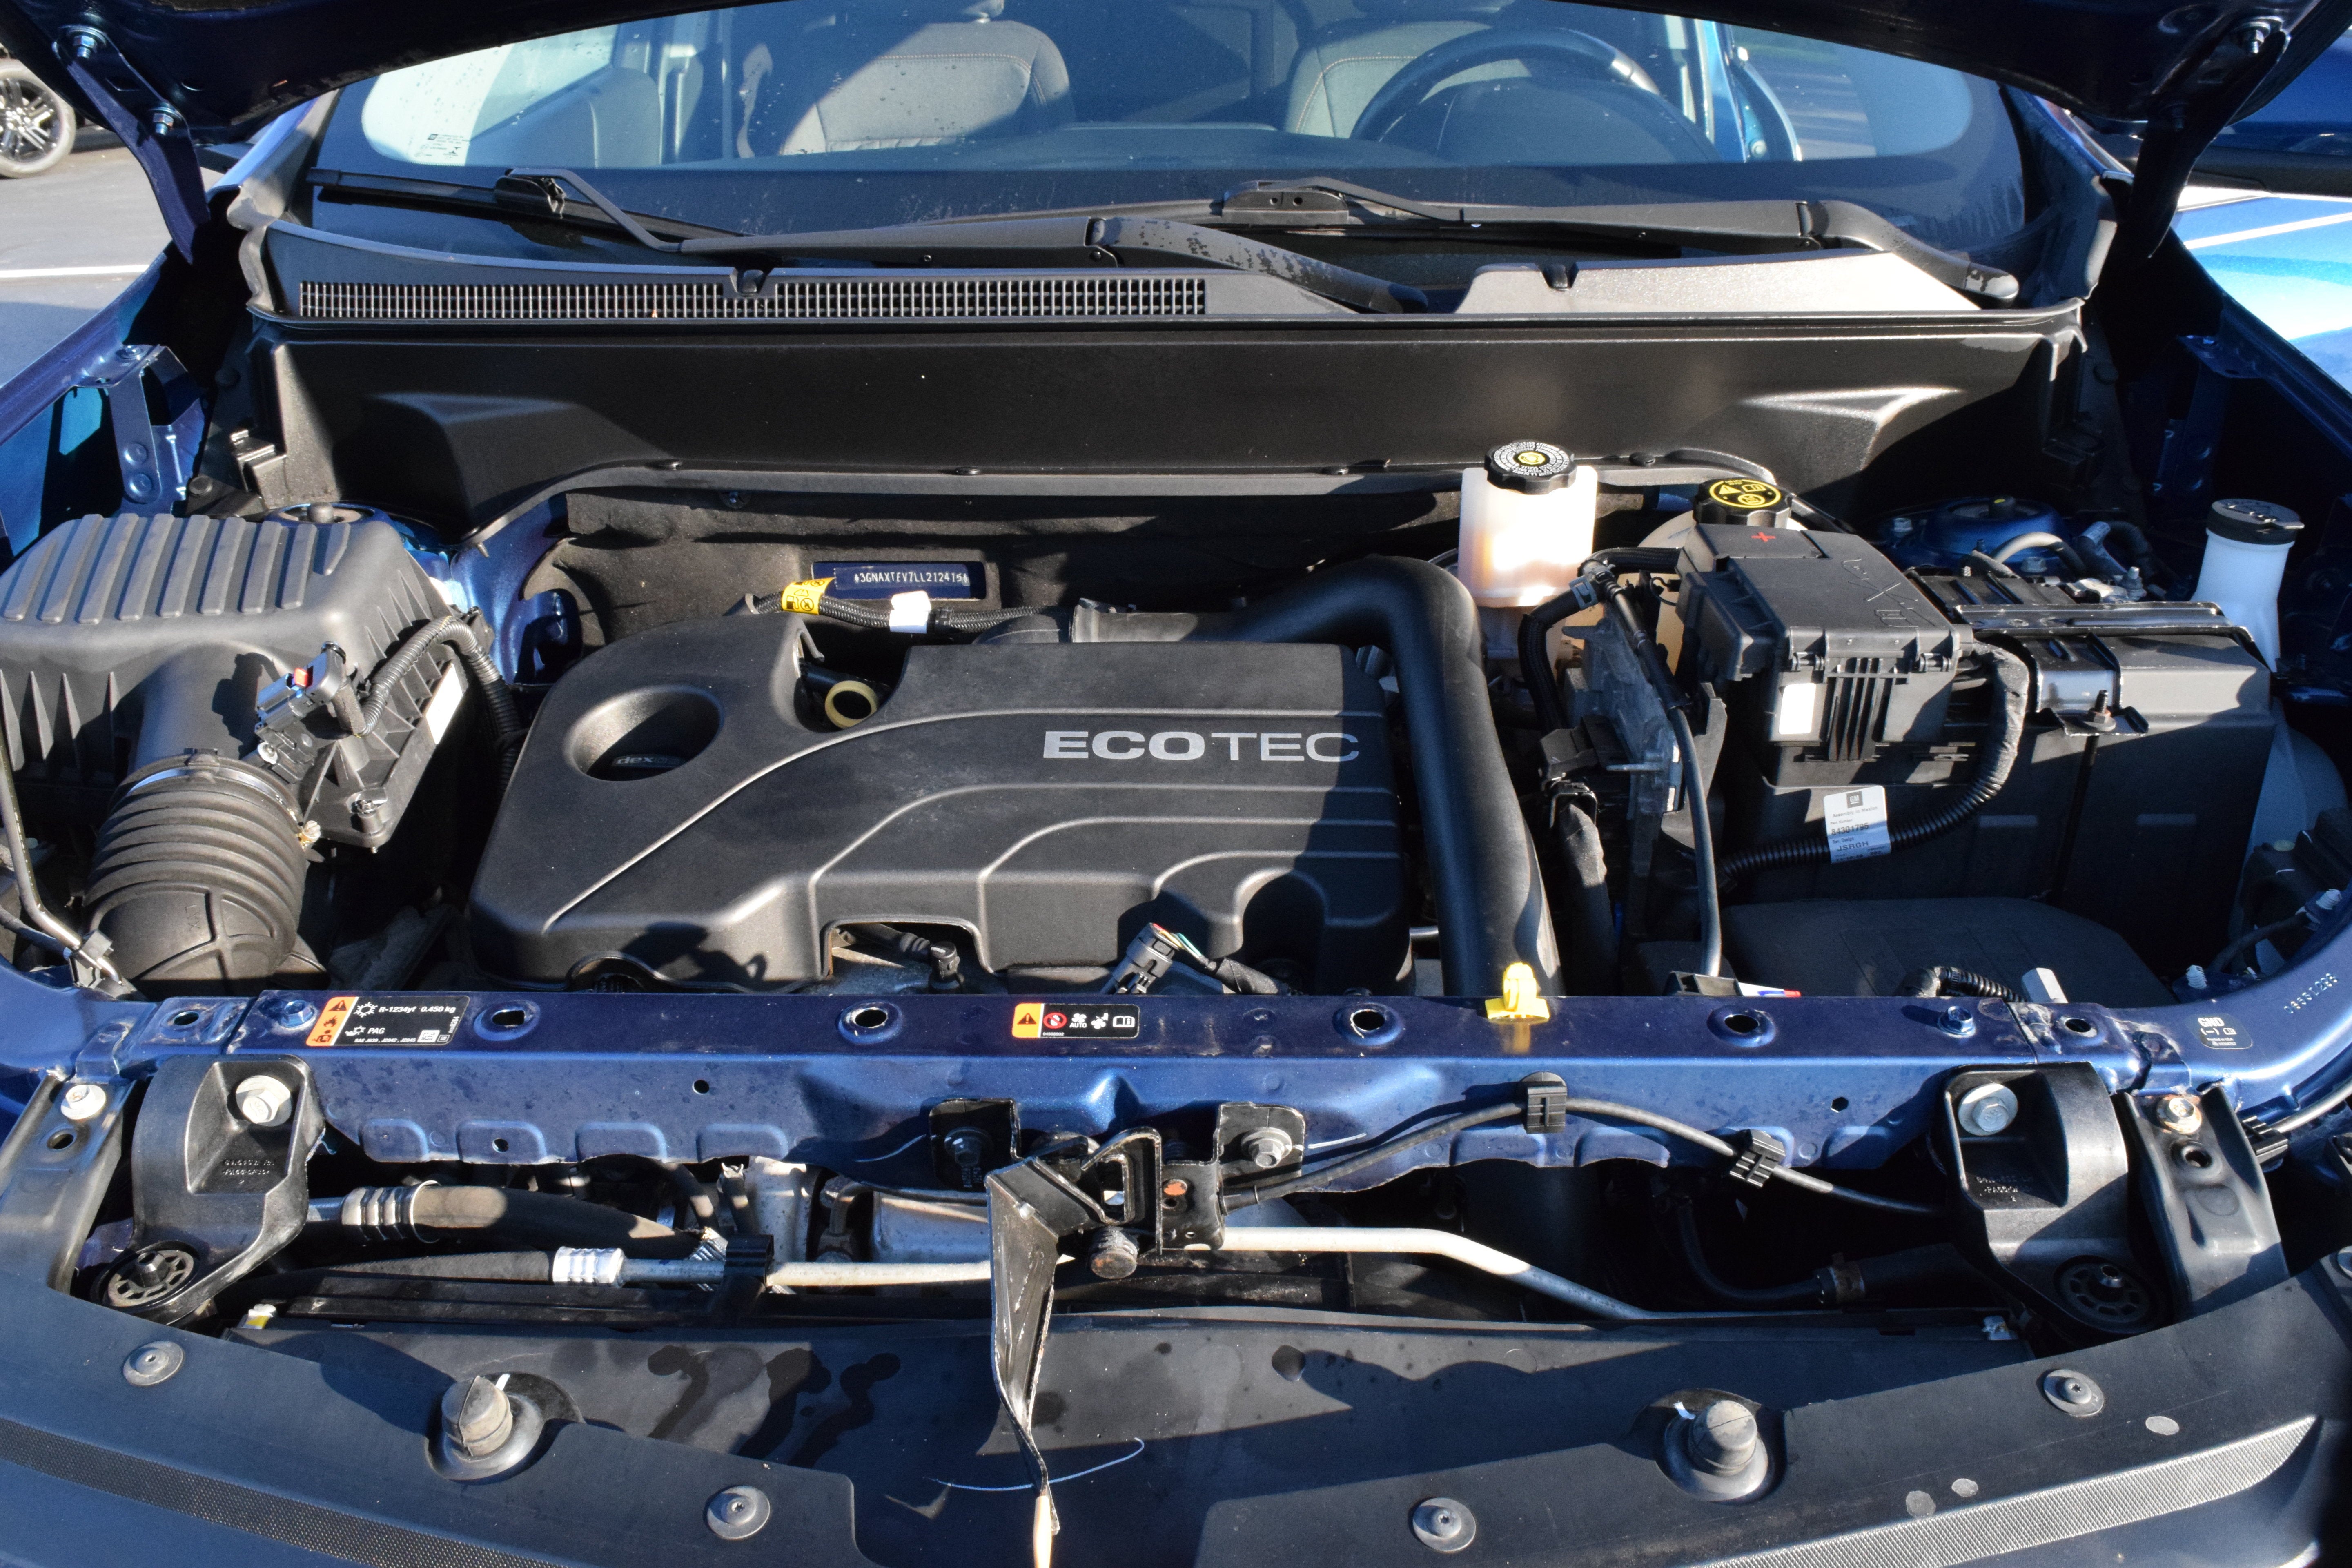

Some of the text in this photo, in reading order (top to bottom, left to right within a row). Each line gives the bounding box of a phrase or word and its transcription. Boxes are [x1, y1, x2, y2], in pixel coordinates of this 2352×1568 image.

[1043, 730, 1359, 762] ECOTEC
[1832, 810, 1854, 818] Assembly
[2198, 1017, 2225, 1027] GND
